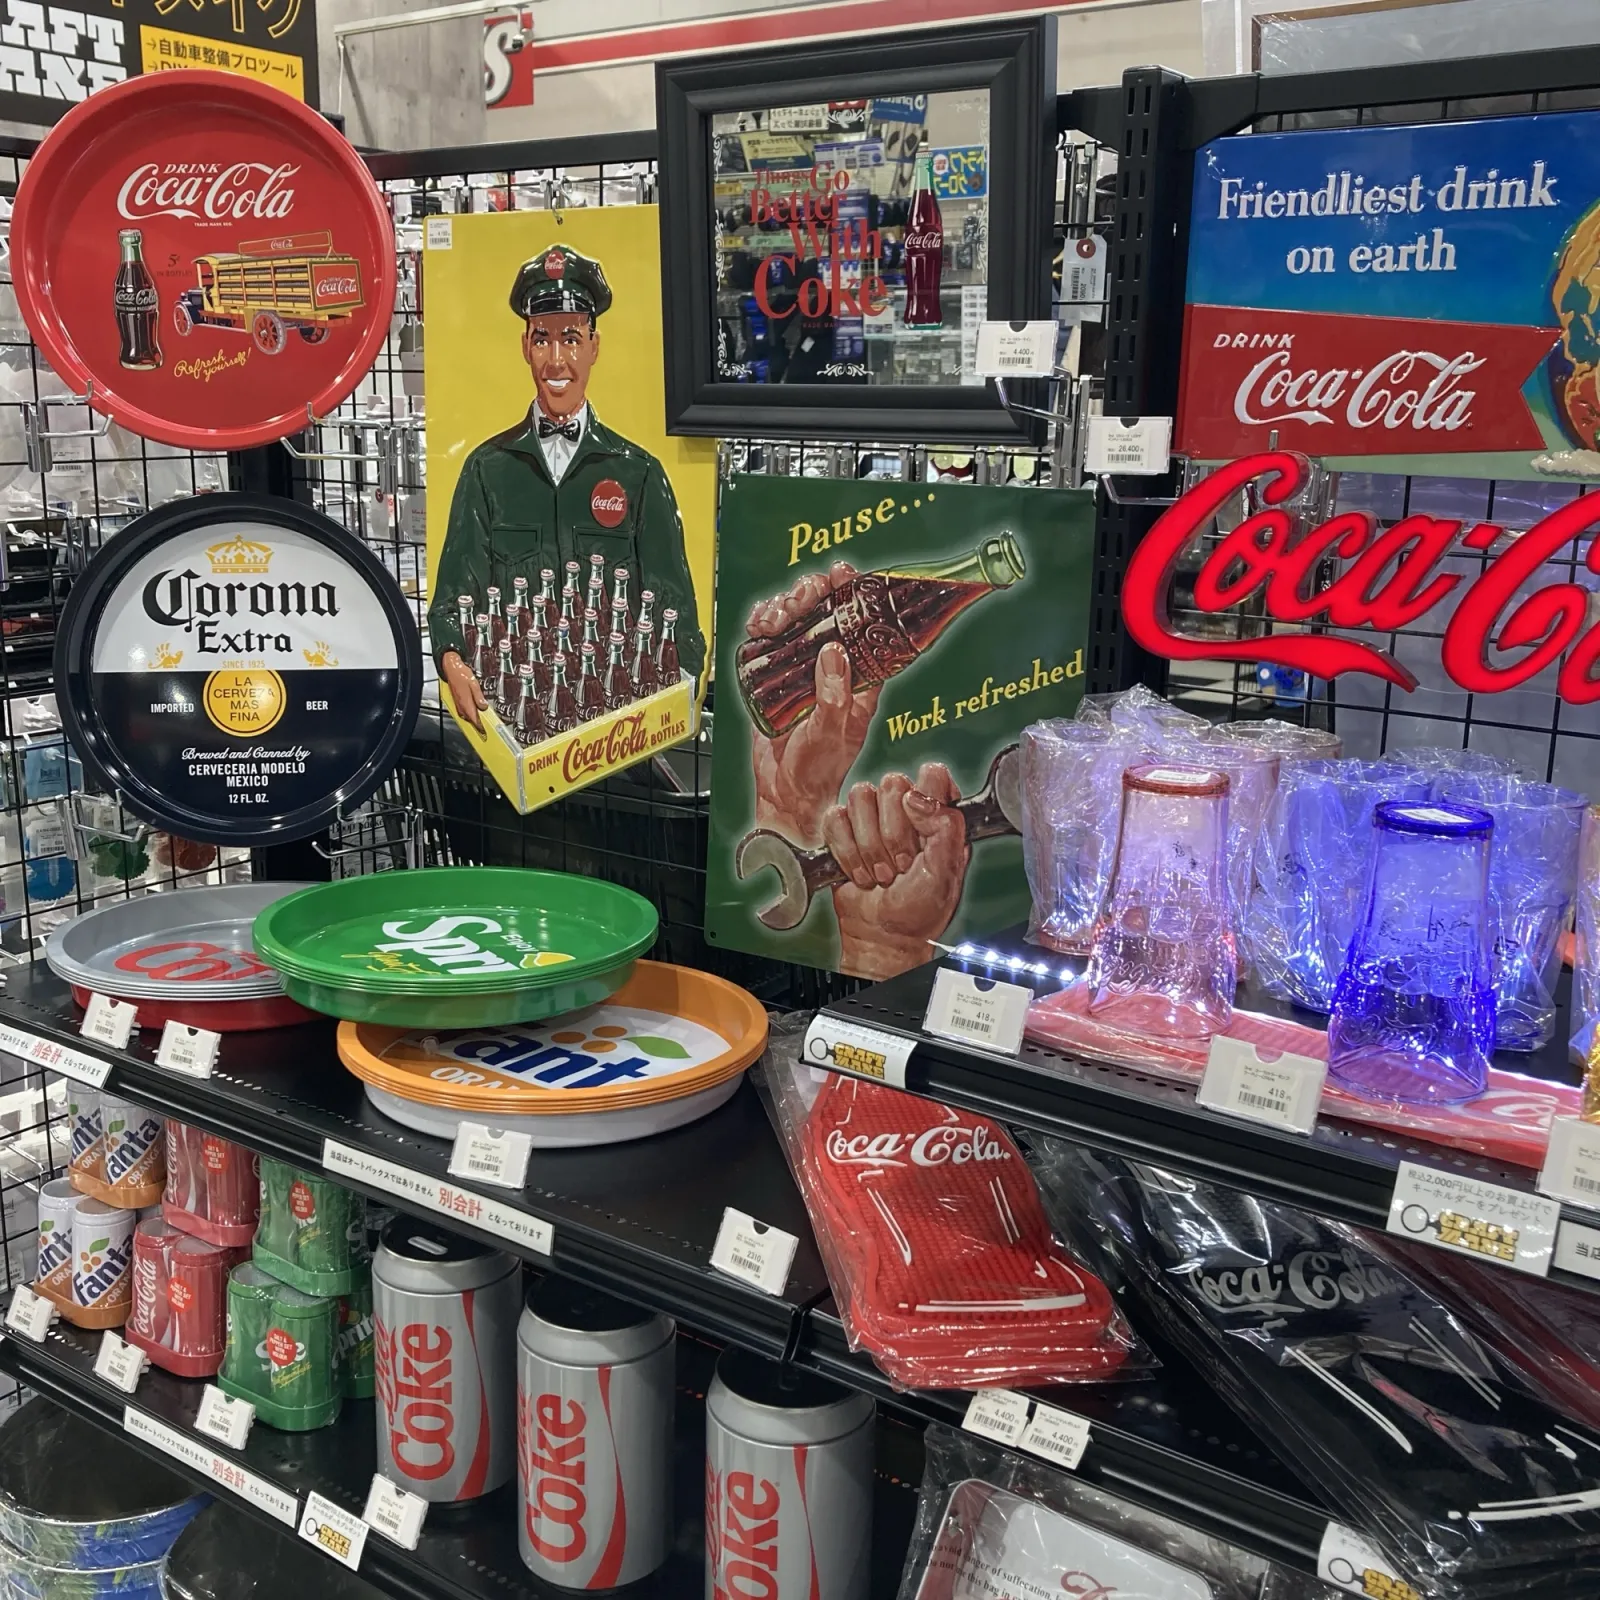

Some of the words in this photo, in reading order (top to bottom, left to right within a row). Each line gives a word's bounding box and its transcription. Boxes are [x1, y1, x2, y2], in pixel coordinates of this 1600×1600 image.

[159, 37, 298, 80] 自動車整備プロツール
[163, 163, 223, 175] DRINK
[810, 162, 850, 193] Go
[116, 162, 301, 220] Coca-Cola
[748, 186, 847, 224] Better
[1217, 168, 1425, 221] Friendliest
[1437, 159, 1560, 212] drink
[788, 219, 883, 261] With
[1286, 244, 1335, 274] on
[1348, 227, 1457, 273] earth
[316, 278, 357, 297] Coca-Cola
[754, 253, 888, 320] Coke
[1212, 332, 1296, 350] DRINK
[173, 348, 227, 379] Refresh
[1233, 350, 1487, 432] Coca-Cola
[591, 496, 624, 511] Coca-Cola
[1121, 451, 1600, 705] Coca-C
[142, 568, 341, 633] Corona
[195, 620, 293, 654] Extra
[222, 660, 245, 669] SINCE
[248, 660, 266, 669] 1925
[234, 676, 253, 687] LA
[885, 696, 948, 742] Work
[954, 649, 1085, 719] refreshed
[150, 702, 195, 713] IMPORTED
[229, 711, 261, 722] FINA
[230, 700, 260, 710] MAS
[305, 700, 329, 711] BEER
[660, 711, 671, 727] IN
[528, 750, 560, 775] DRINK
[562, 709, 648, 784] Coca-Cola
[650, 720, 686, 746] BOTTLES
[181, 746, 228, 761] Brewed
[227, 746, 252, 760] and
[295, 745, 311, 761] by
[188, 763, 258, 776] CERVECERIA
[260, 762, 306, 775] MODELO
[225, 775, 269, 788] MEXICO
[228, 794, 239, 804] 12
[255, 793, 270, 803] OZ.
[105, 1118, 161, 1185] anta
[826, 1126, 1006, 1168] Coca-Cola
[438, 1186, 483, 1221] 別会計
[487, 1211, 543, 1240] となっております
[391, 1323, 455, 1481] Coke
[211, 1458, 246, 1490] 別会計
[249, 1485, 291, 1513] となっております
[525, 1394, 587, 1563] Coke
[713, 1471, 780, 1600] oke
[967, 1572, 981, 1584] this
[983, 1580, 1000, 1598] bag
[991, 1567, 1002, 1577] of
